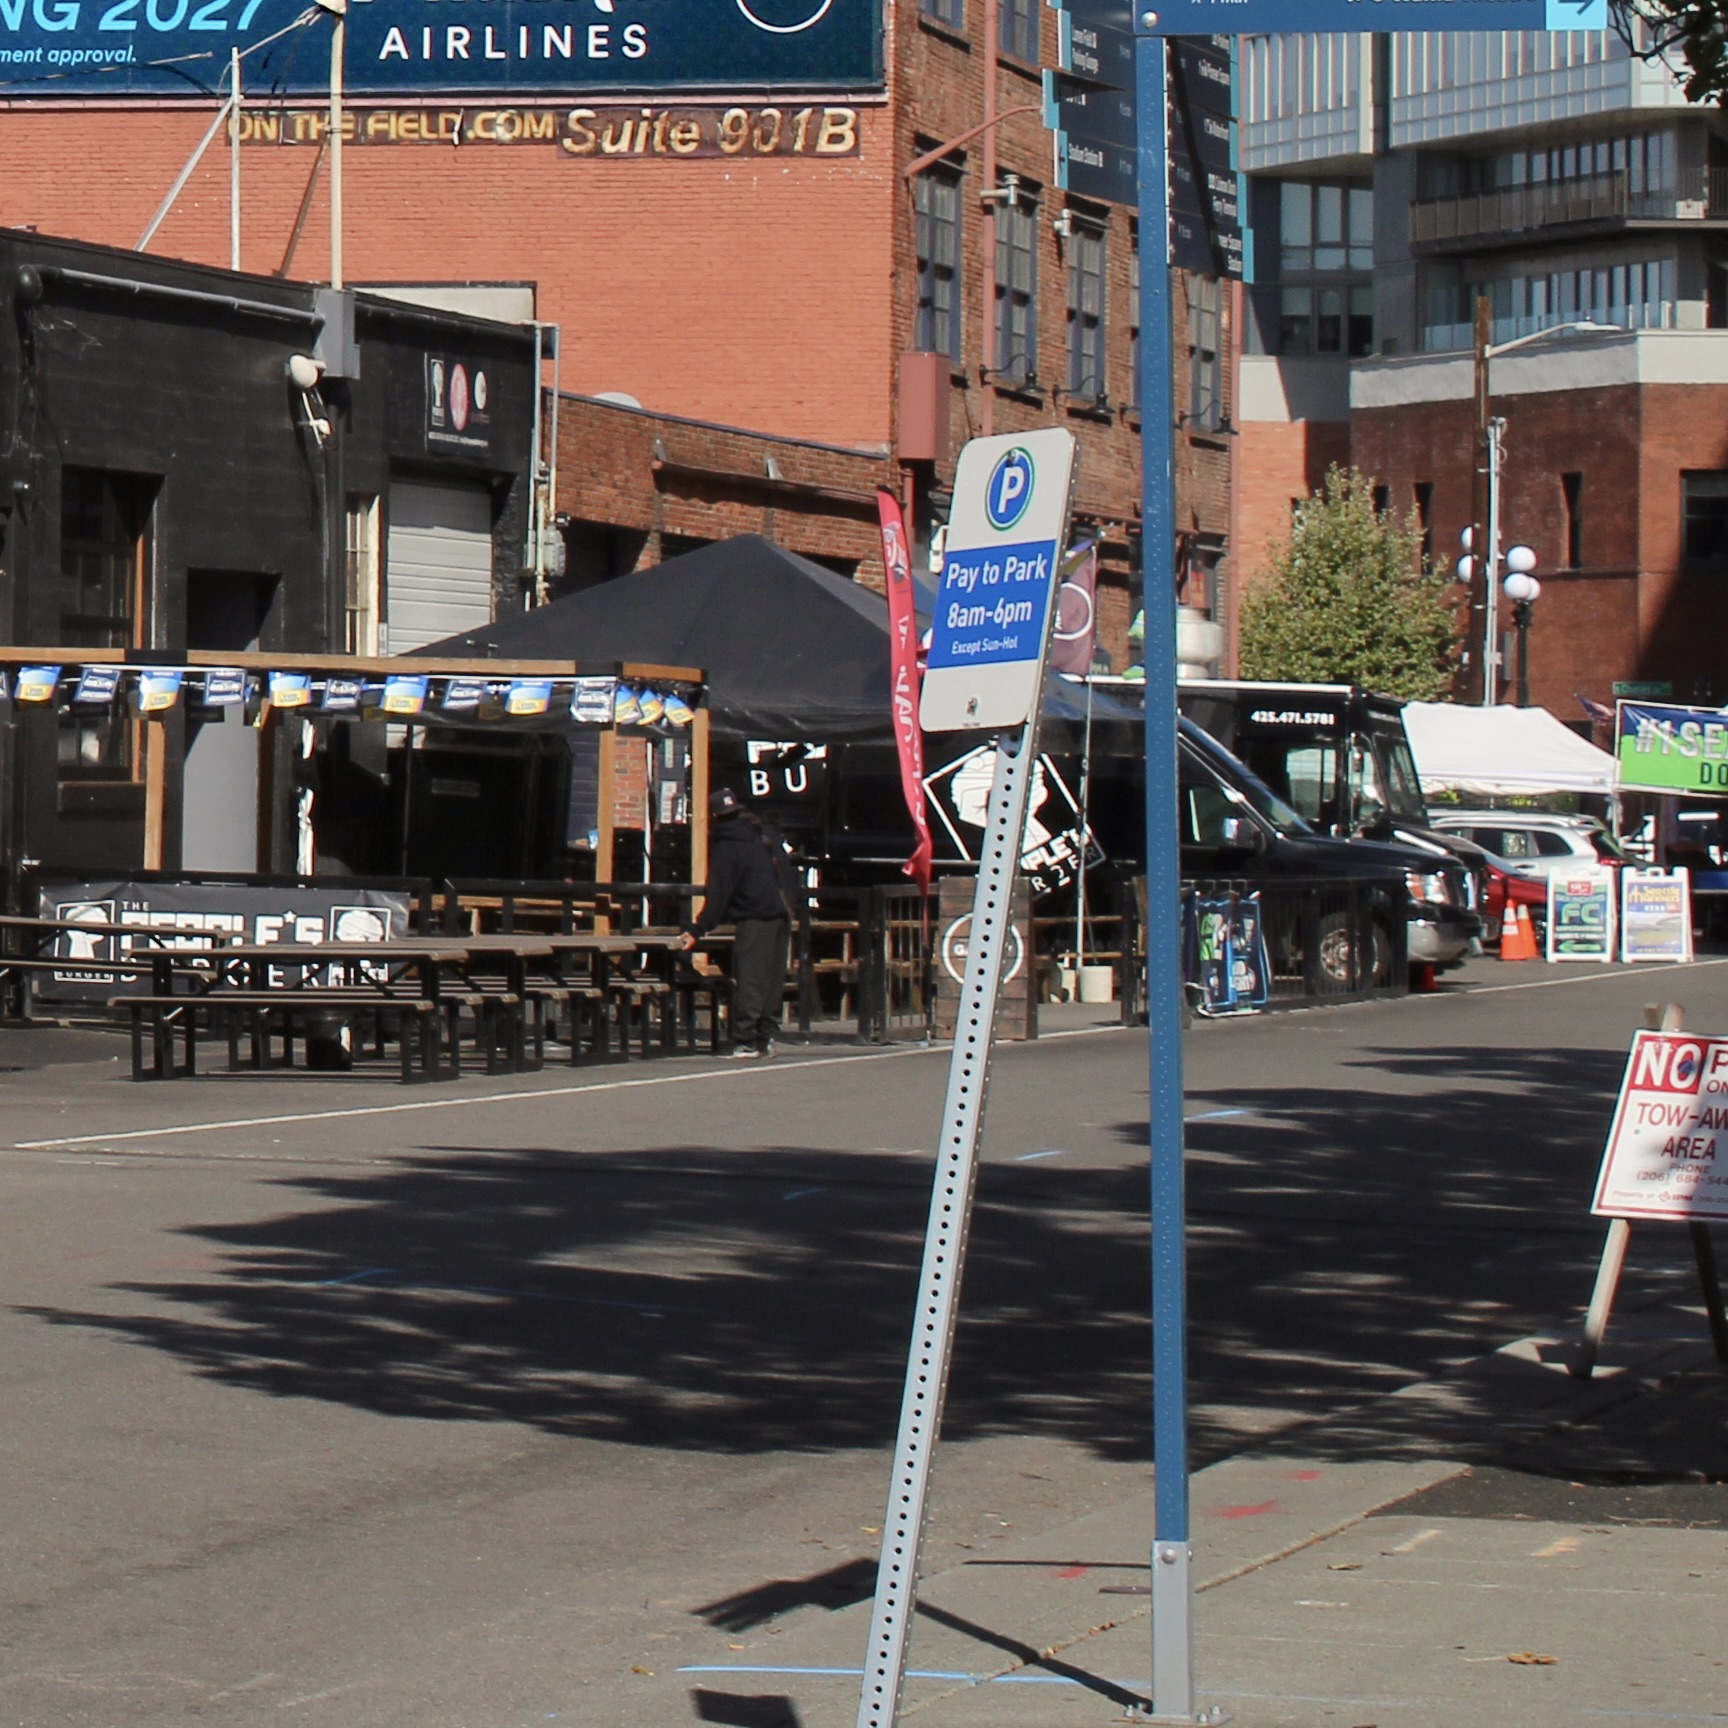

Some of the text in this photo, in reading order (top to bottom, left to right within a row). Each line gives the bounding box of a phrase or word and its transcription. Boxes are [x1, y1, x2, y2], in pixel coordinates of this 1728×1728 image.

[379, 25, 647, 61] AIRLINES
[48, 45, 137, 66] approval.
[562, 108, 701, 154] Suite
[998, 466, 1025, 514] P
[946, 553, 1047, 593] Pay to Park
[947, 598, 1032, 629] 8am-6pm
[951, 636, 1018, 655] Except Sun-Hol
[1251, 711, 1335, 724] 425.471.5781
[1635, 718, 1728, 758] #1 SE
[122, 901, 149, 910] THE
[1561, 903, 1600, 924] FC
[1635, 1042, 1702, 1088] NO
[1662, 1138, 1716, 1160] AREA
[1637, 1171, 1669, 1182] (206)
[1670, 1163, 1711, 1174] PHONE
